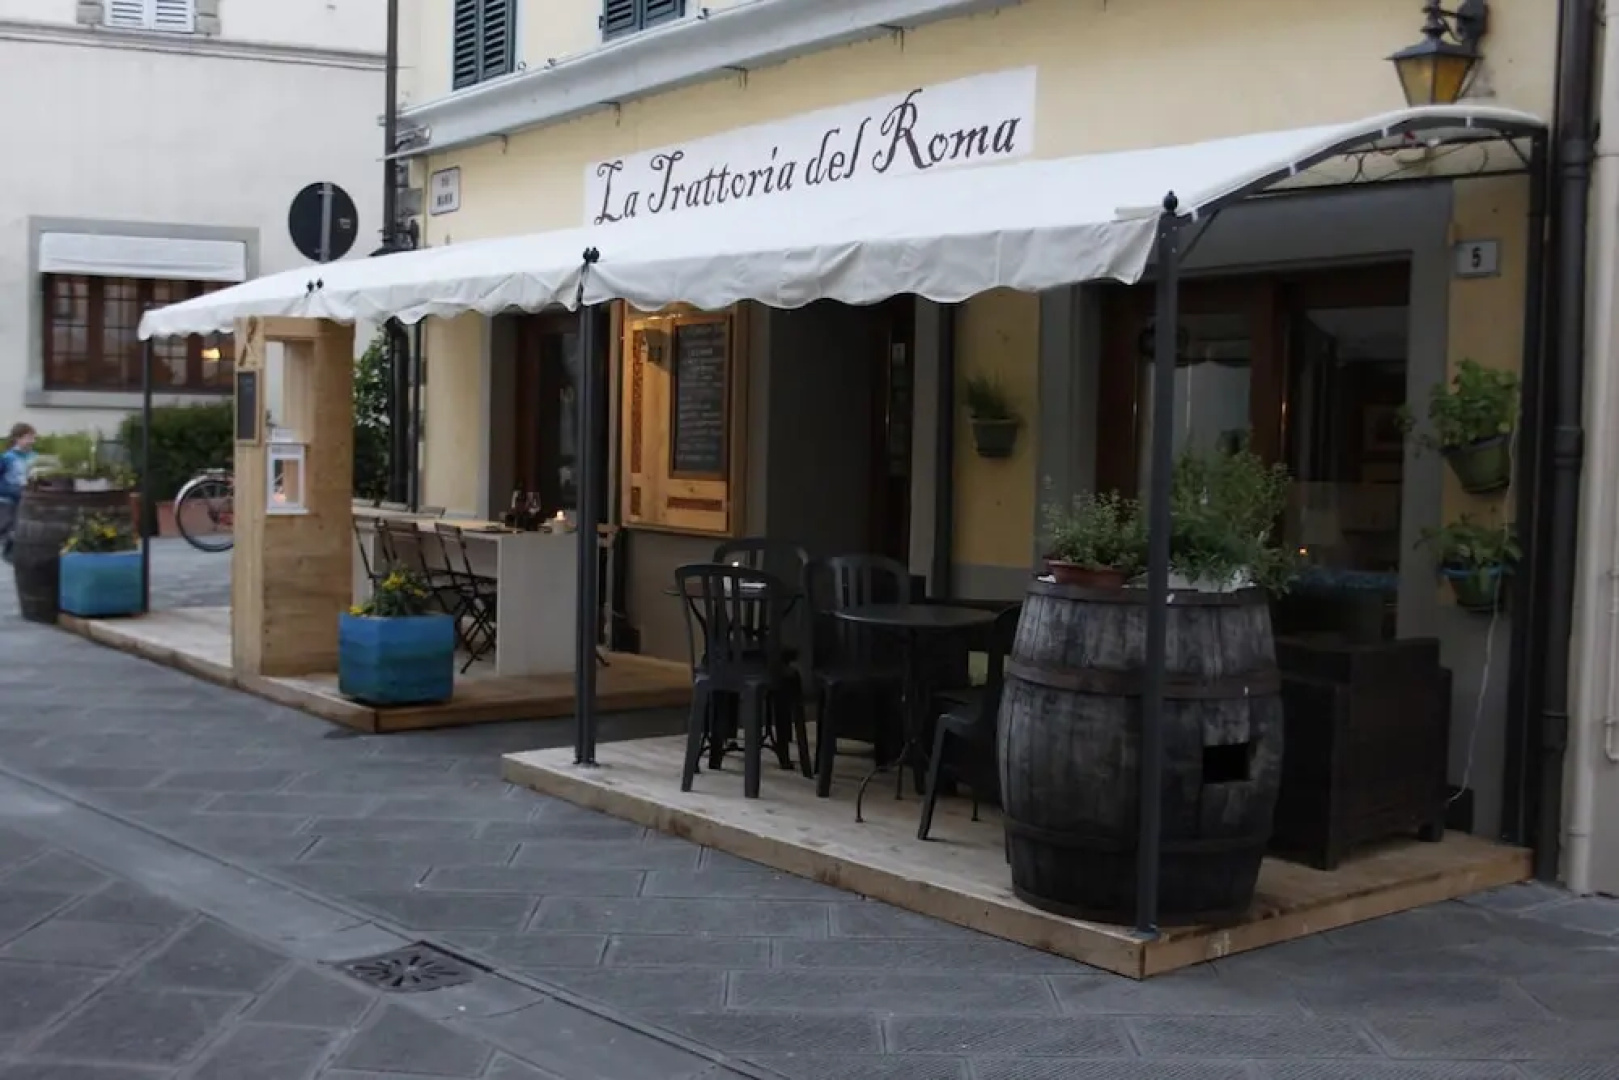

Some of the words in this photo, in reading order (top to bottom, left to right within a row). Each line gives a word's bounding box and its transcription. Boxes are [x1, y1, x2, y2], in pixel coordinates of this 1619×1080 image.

[593, 160, 639, 225] La
[647, 146, 796, 214] Trattoria
[804, 116, 872, 185] del
[872, 88, 1021, 174] Roma
[1471, 246, 1482, 269] 5
